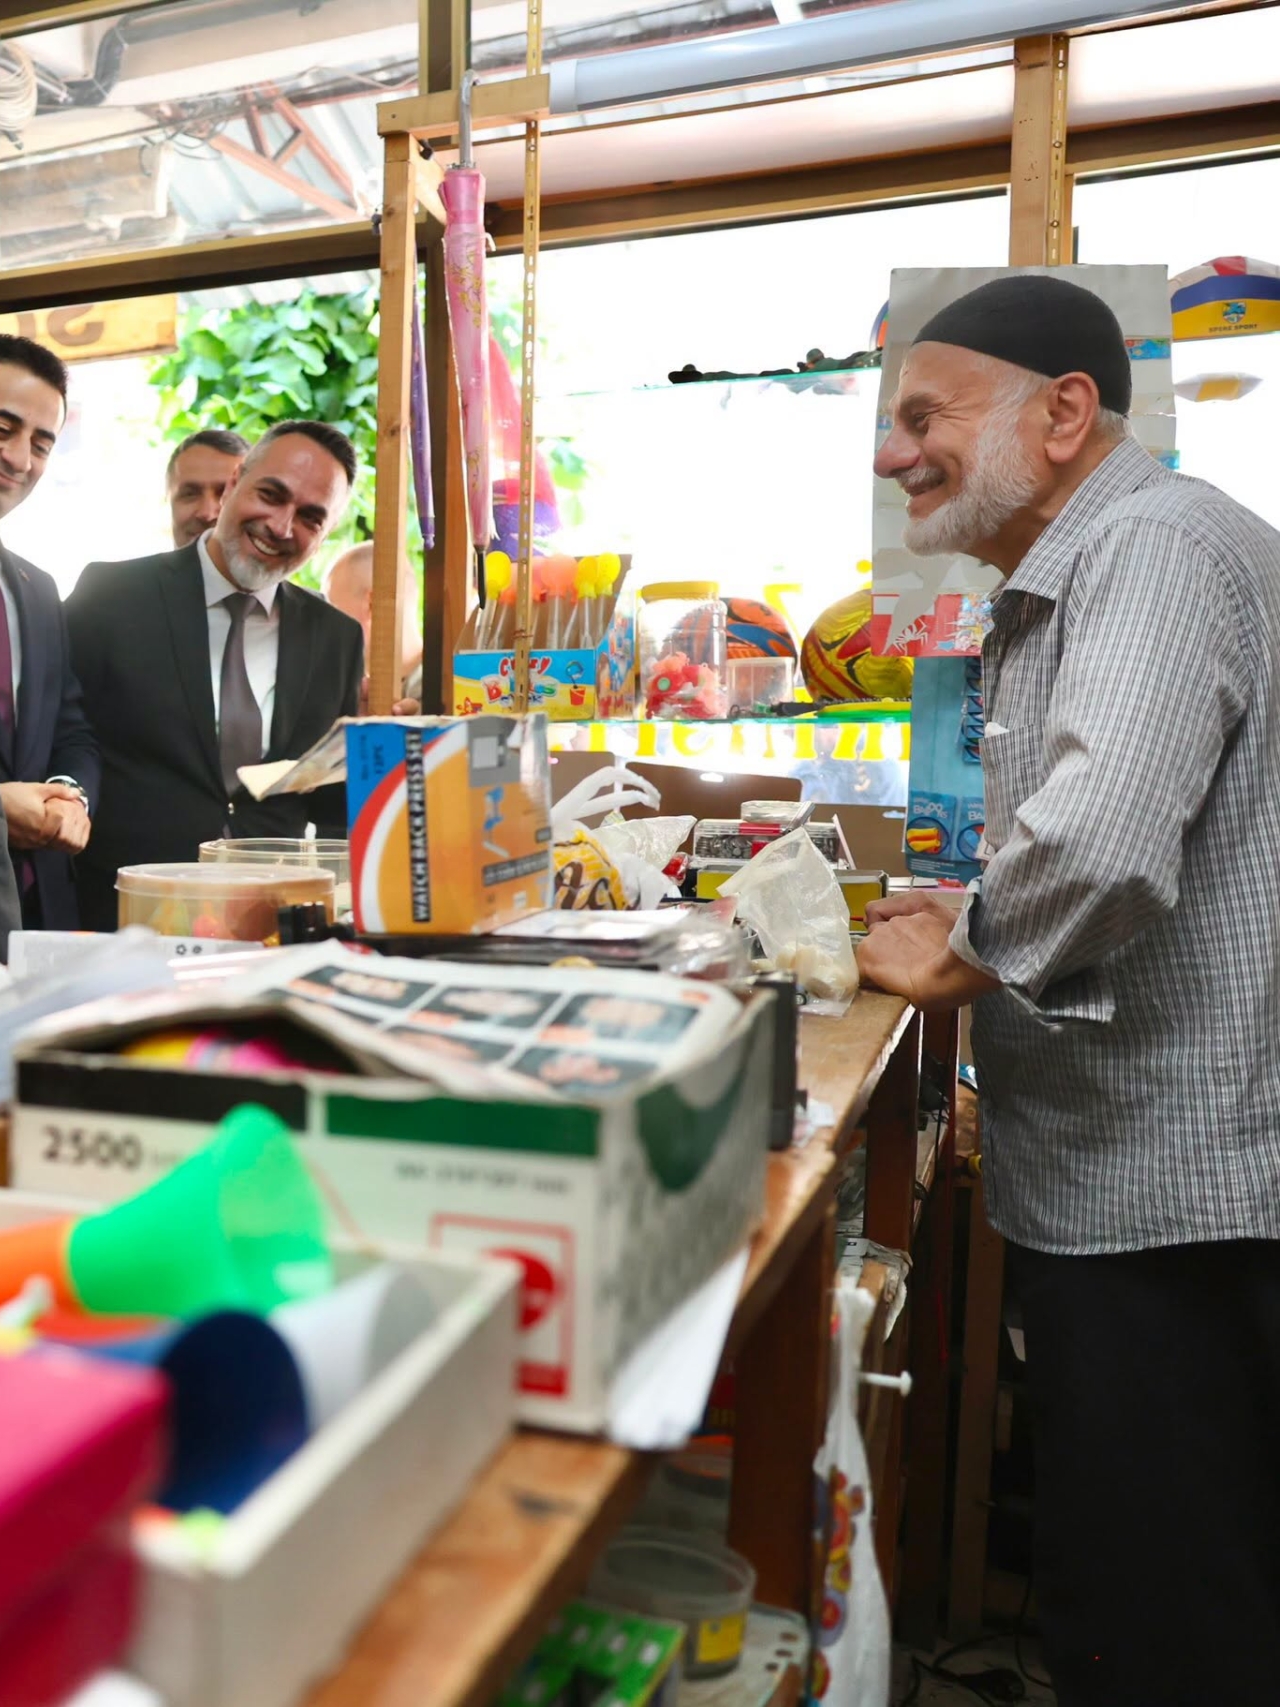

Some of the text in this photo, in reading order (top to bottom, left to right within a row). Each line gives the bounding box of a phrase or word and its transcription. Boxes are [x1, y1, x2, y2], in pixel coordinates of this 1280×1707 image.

[1234, 323, 1258, 331] SPORT
[406, 732, 430, 921] WATCH BACK PRESS SET
[41, 1123, 143, 1171] 2500
